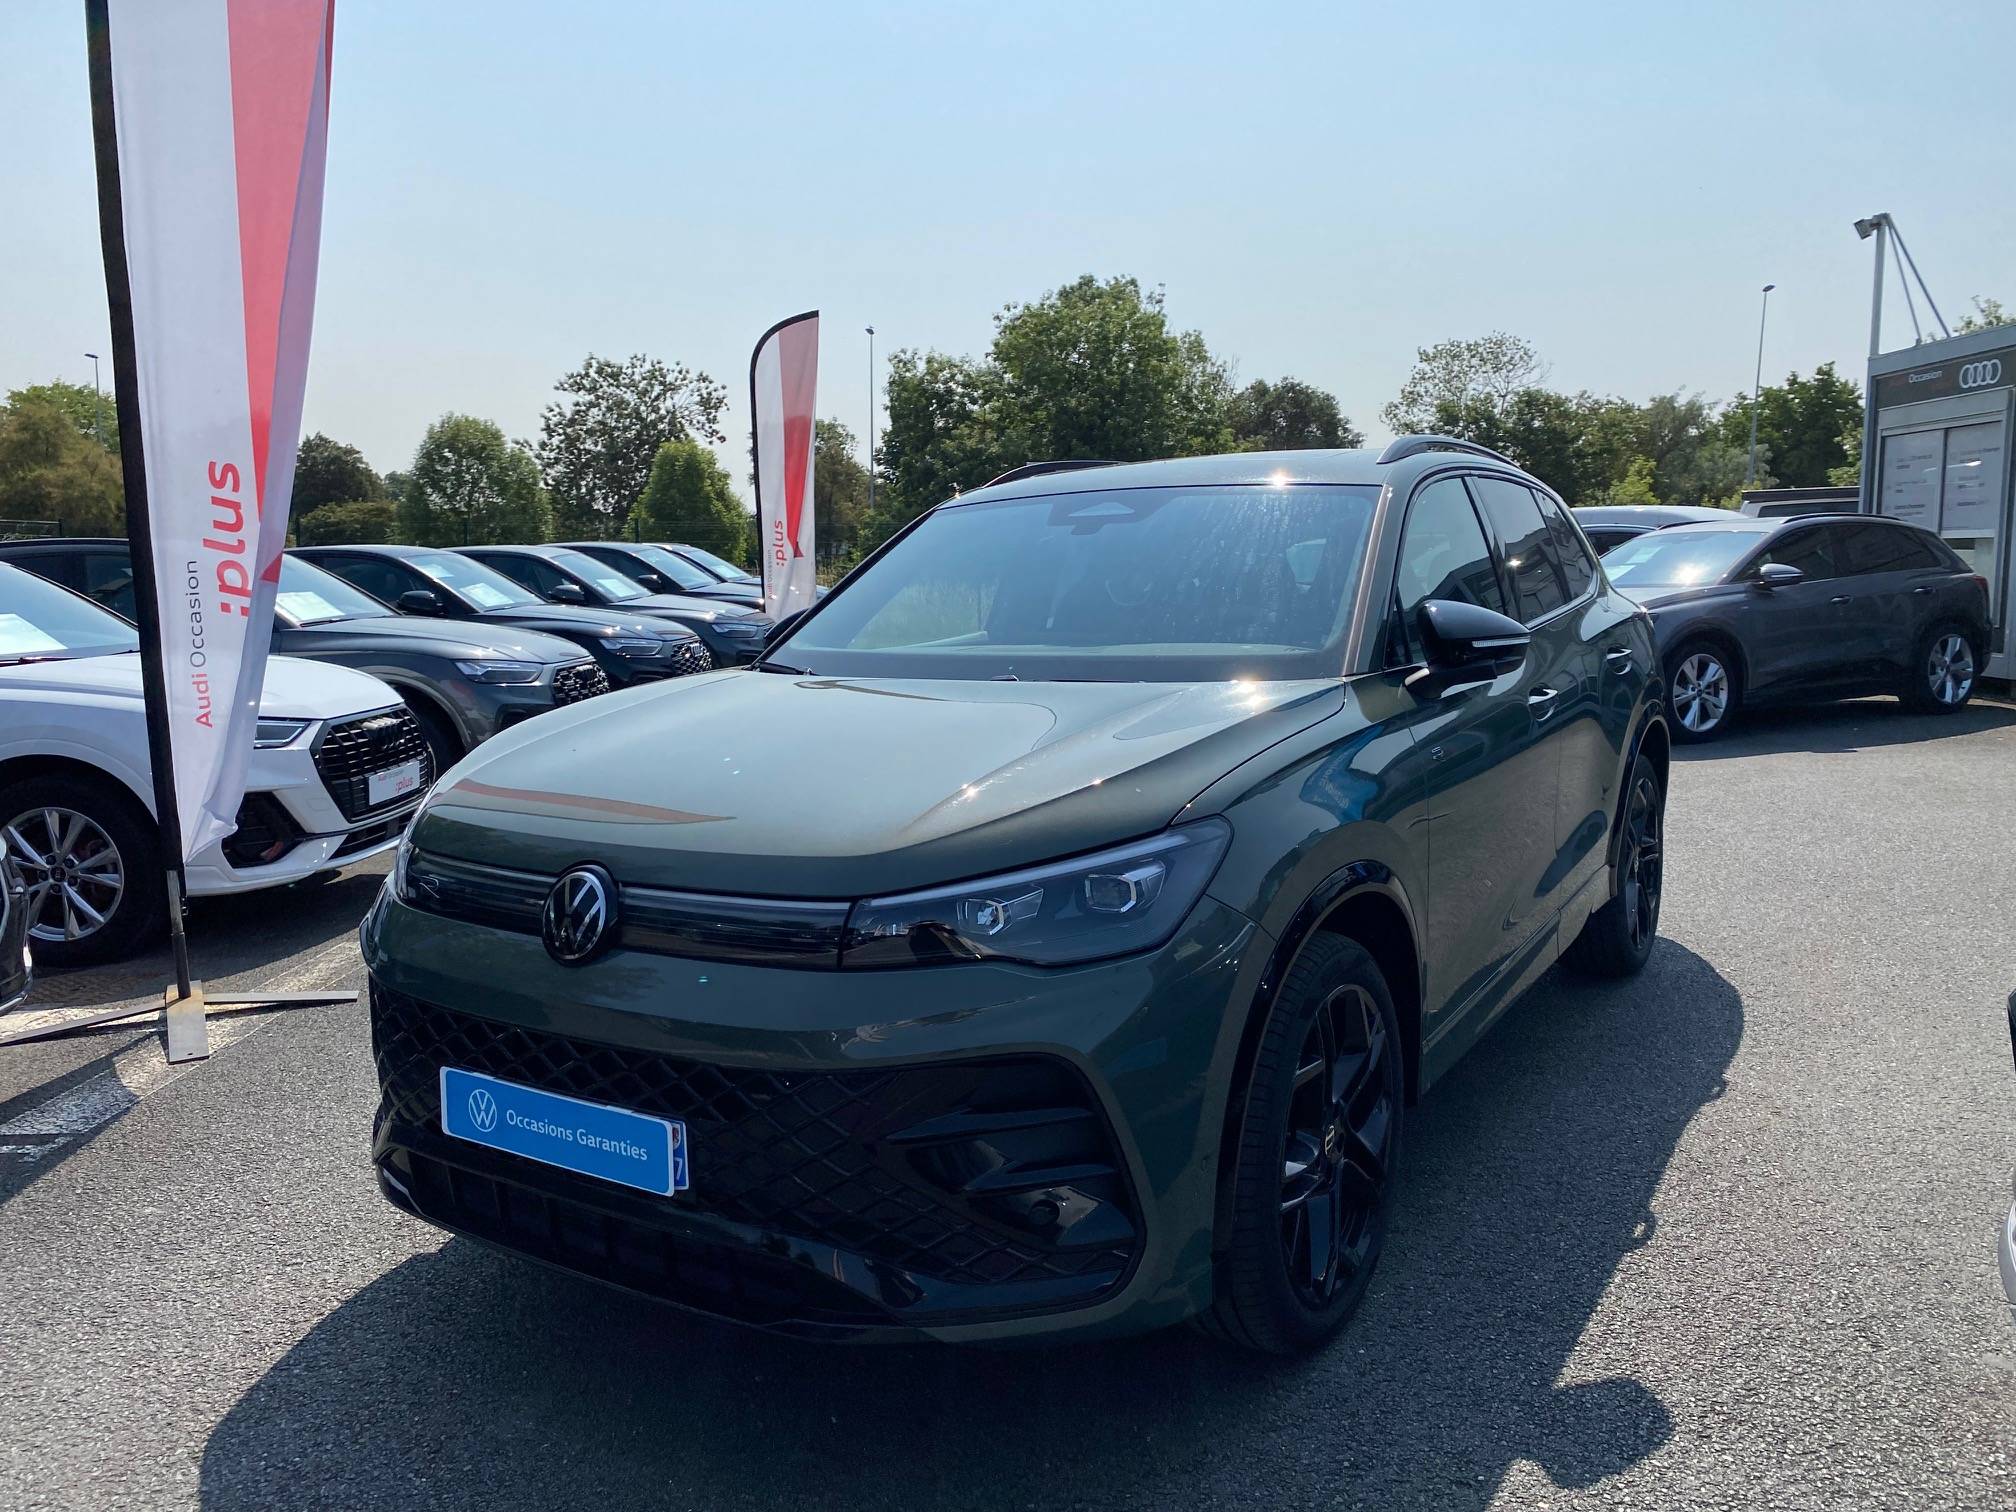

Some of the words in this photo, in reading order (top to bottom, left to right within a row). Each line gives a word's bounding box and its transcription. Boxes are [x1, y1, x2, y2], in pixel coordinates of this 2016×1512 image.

[203, 460, 252, 618] :plus
[773, 520, 787, 567] :plus
[185, 560, 207, 668] Occasion
[192, 673, 213, 729] Audi
[506, 1109, 573, 1142] Occasions
[576, 1128, 648, 1161] Garanties
